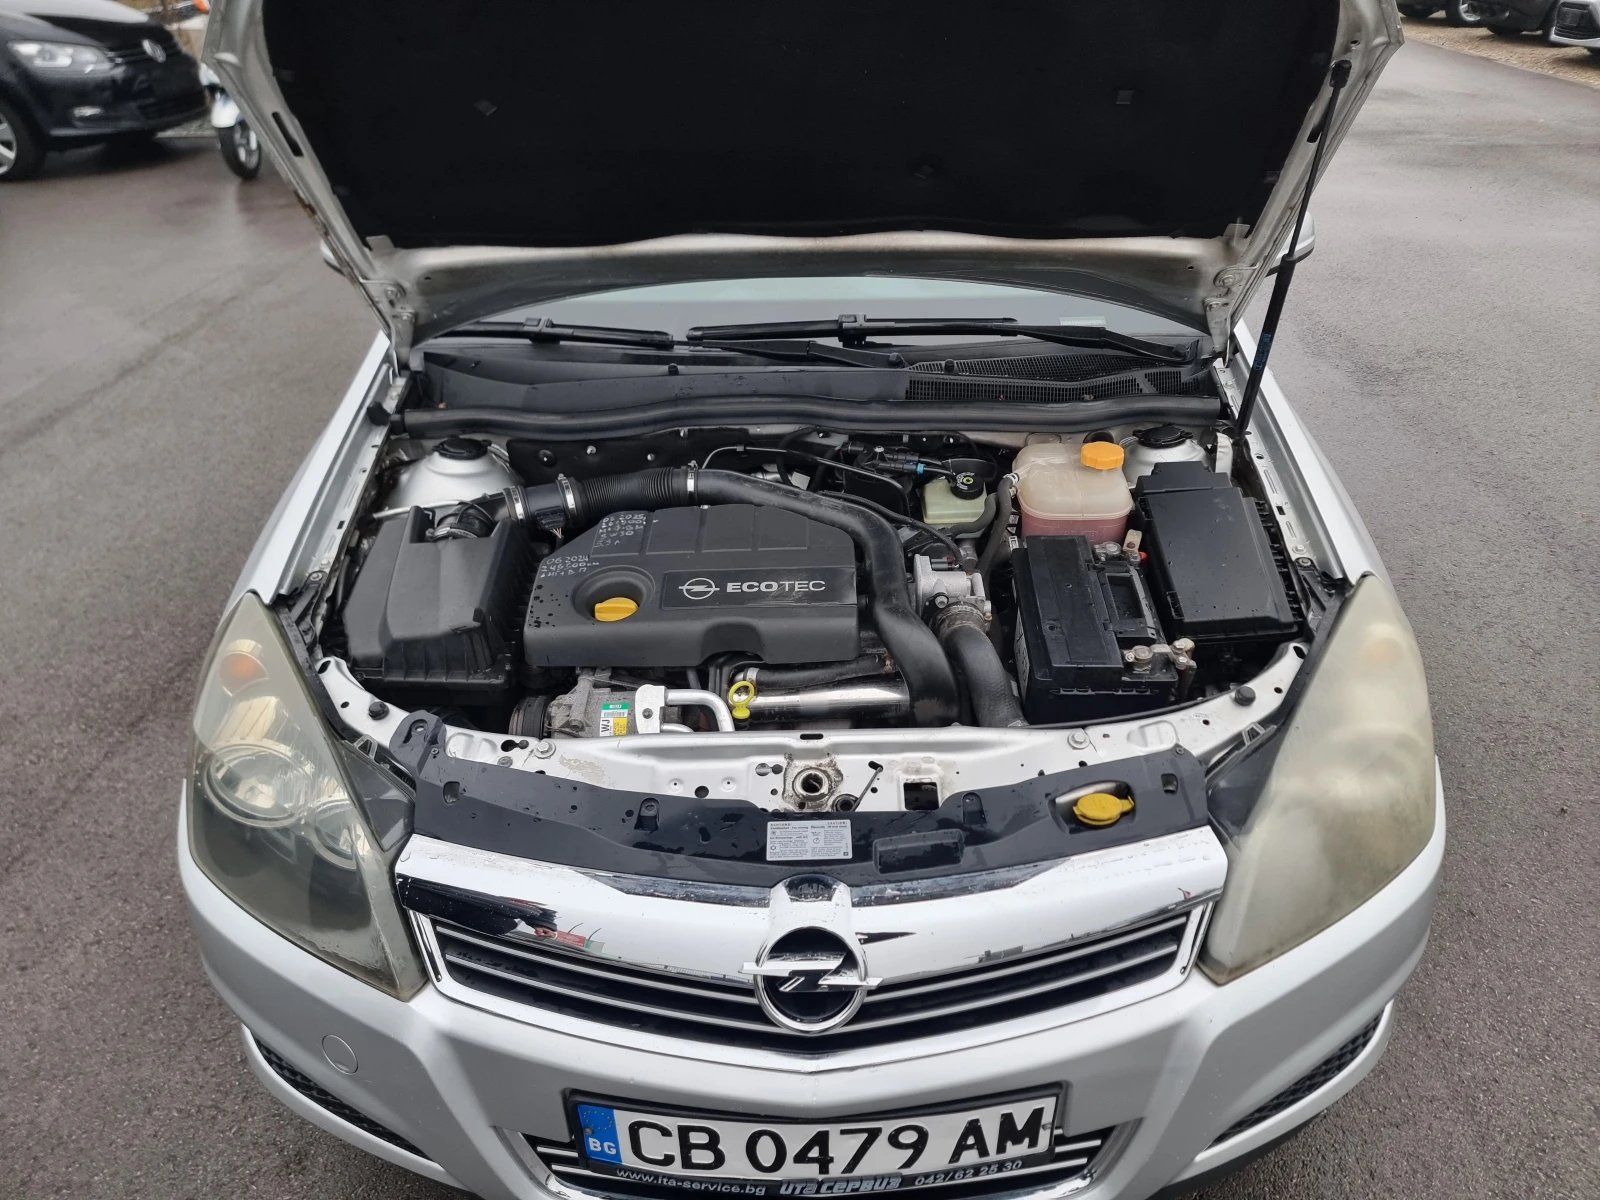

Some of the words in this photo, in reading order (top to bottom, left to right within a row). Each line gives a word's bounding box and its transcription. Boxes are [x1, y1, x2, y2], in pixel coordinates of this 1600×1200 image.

[565, 555, 589, 563] 2024
[726, 580, 826, 593] ECOTEC
[601, 719, 611, 733] WJ
[588, 1137, 617, 1155] BG
[628, 1120, 726, 1171] CB
[745, 1124, 929, 1175] 0479
[948, 1106, 1045, 1165] AM
[616, 1168, 766, 1196] www.ita-service.bg
[914, 1170, 974, 1186] 042/62
[979, 1163, 998, 1177] 25
[1002, 1160, 1022, 1172] 30
